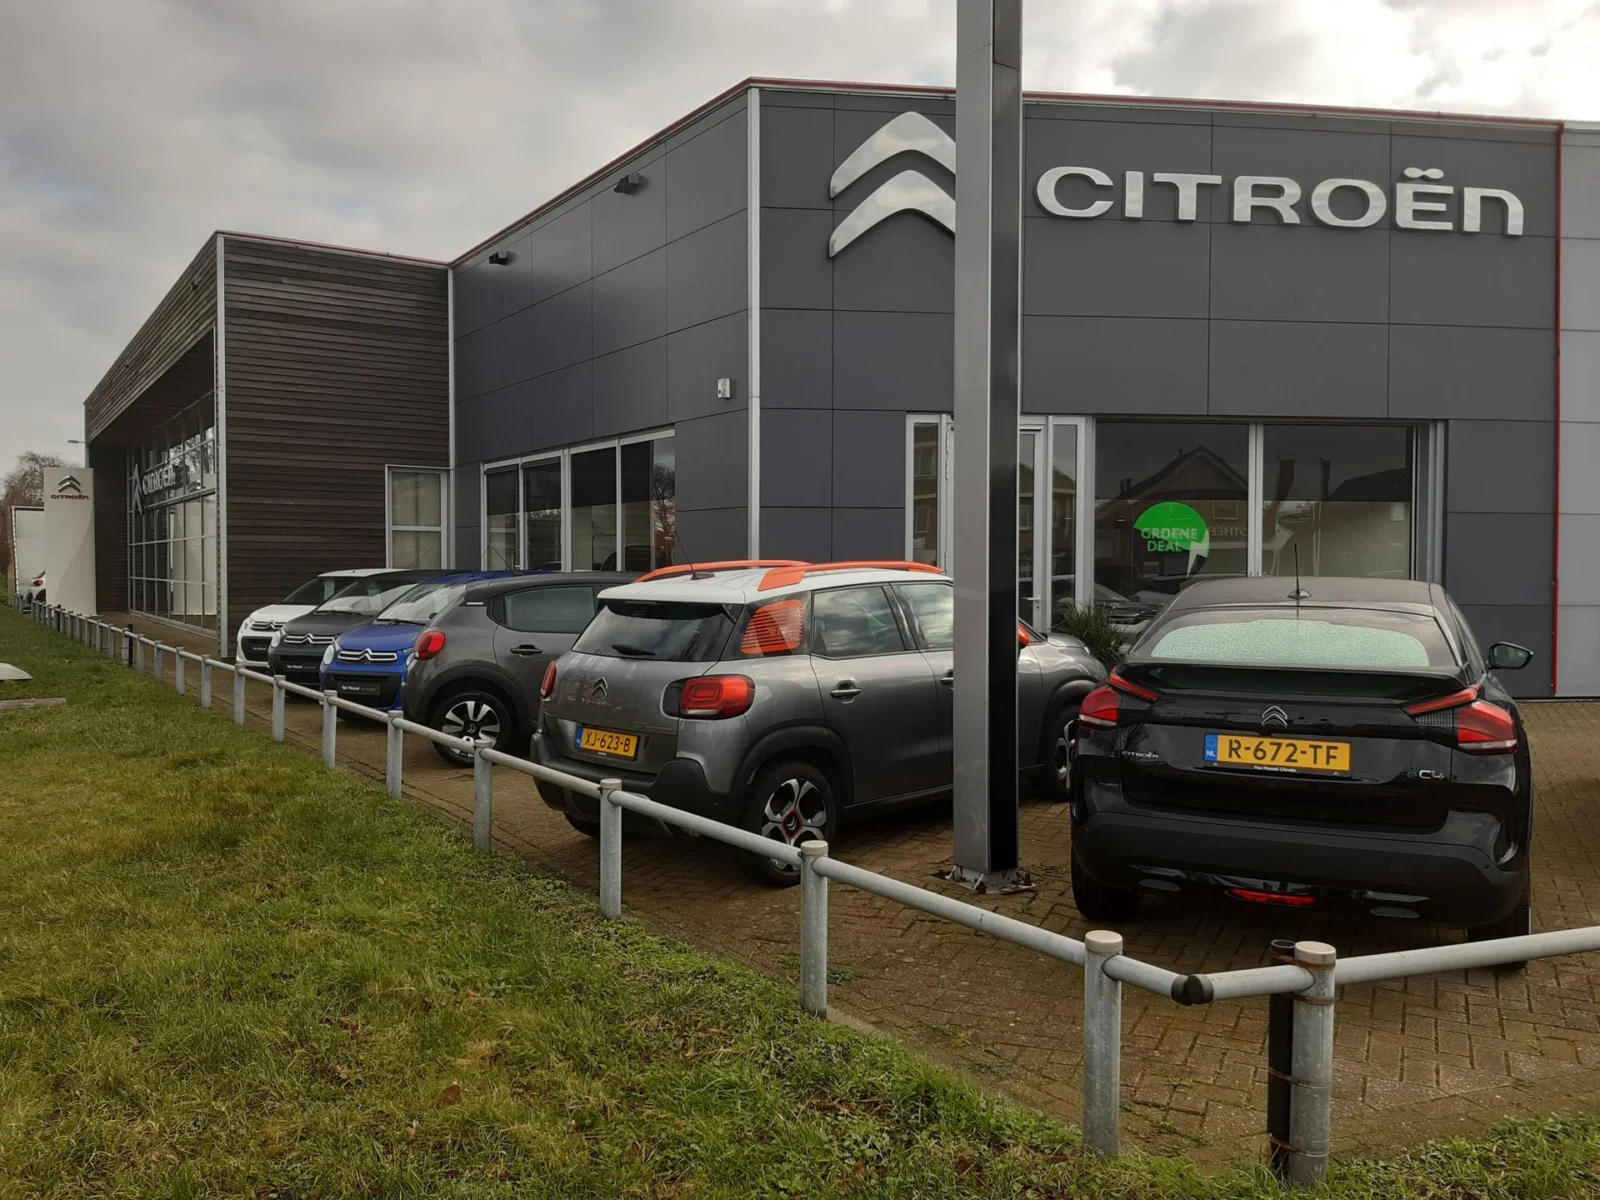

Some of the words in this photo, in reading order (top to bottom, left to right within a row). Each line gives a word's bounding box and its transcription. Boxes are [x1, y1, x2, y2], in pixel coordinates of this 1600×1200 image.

[1036, 166, 1524, 236] CITROËN
[1140, 527, 1198, 539] GROENE
[1147, 540, 1182, 552] DEAL
[585, 731, 631, 753] XJ-623-B
[1205, 749, 1216, 757] NL
[1228, 739, 1339, 765] R-672-TF
